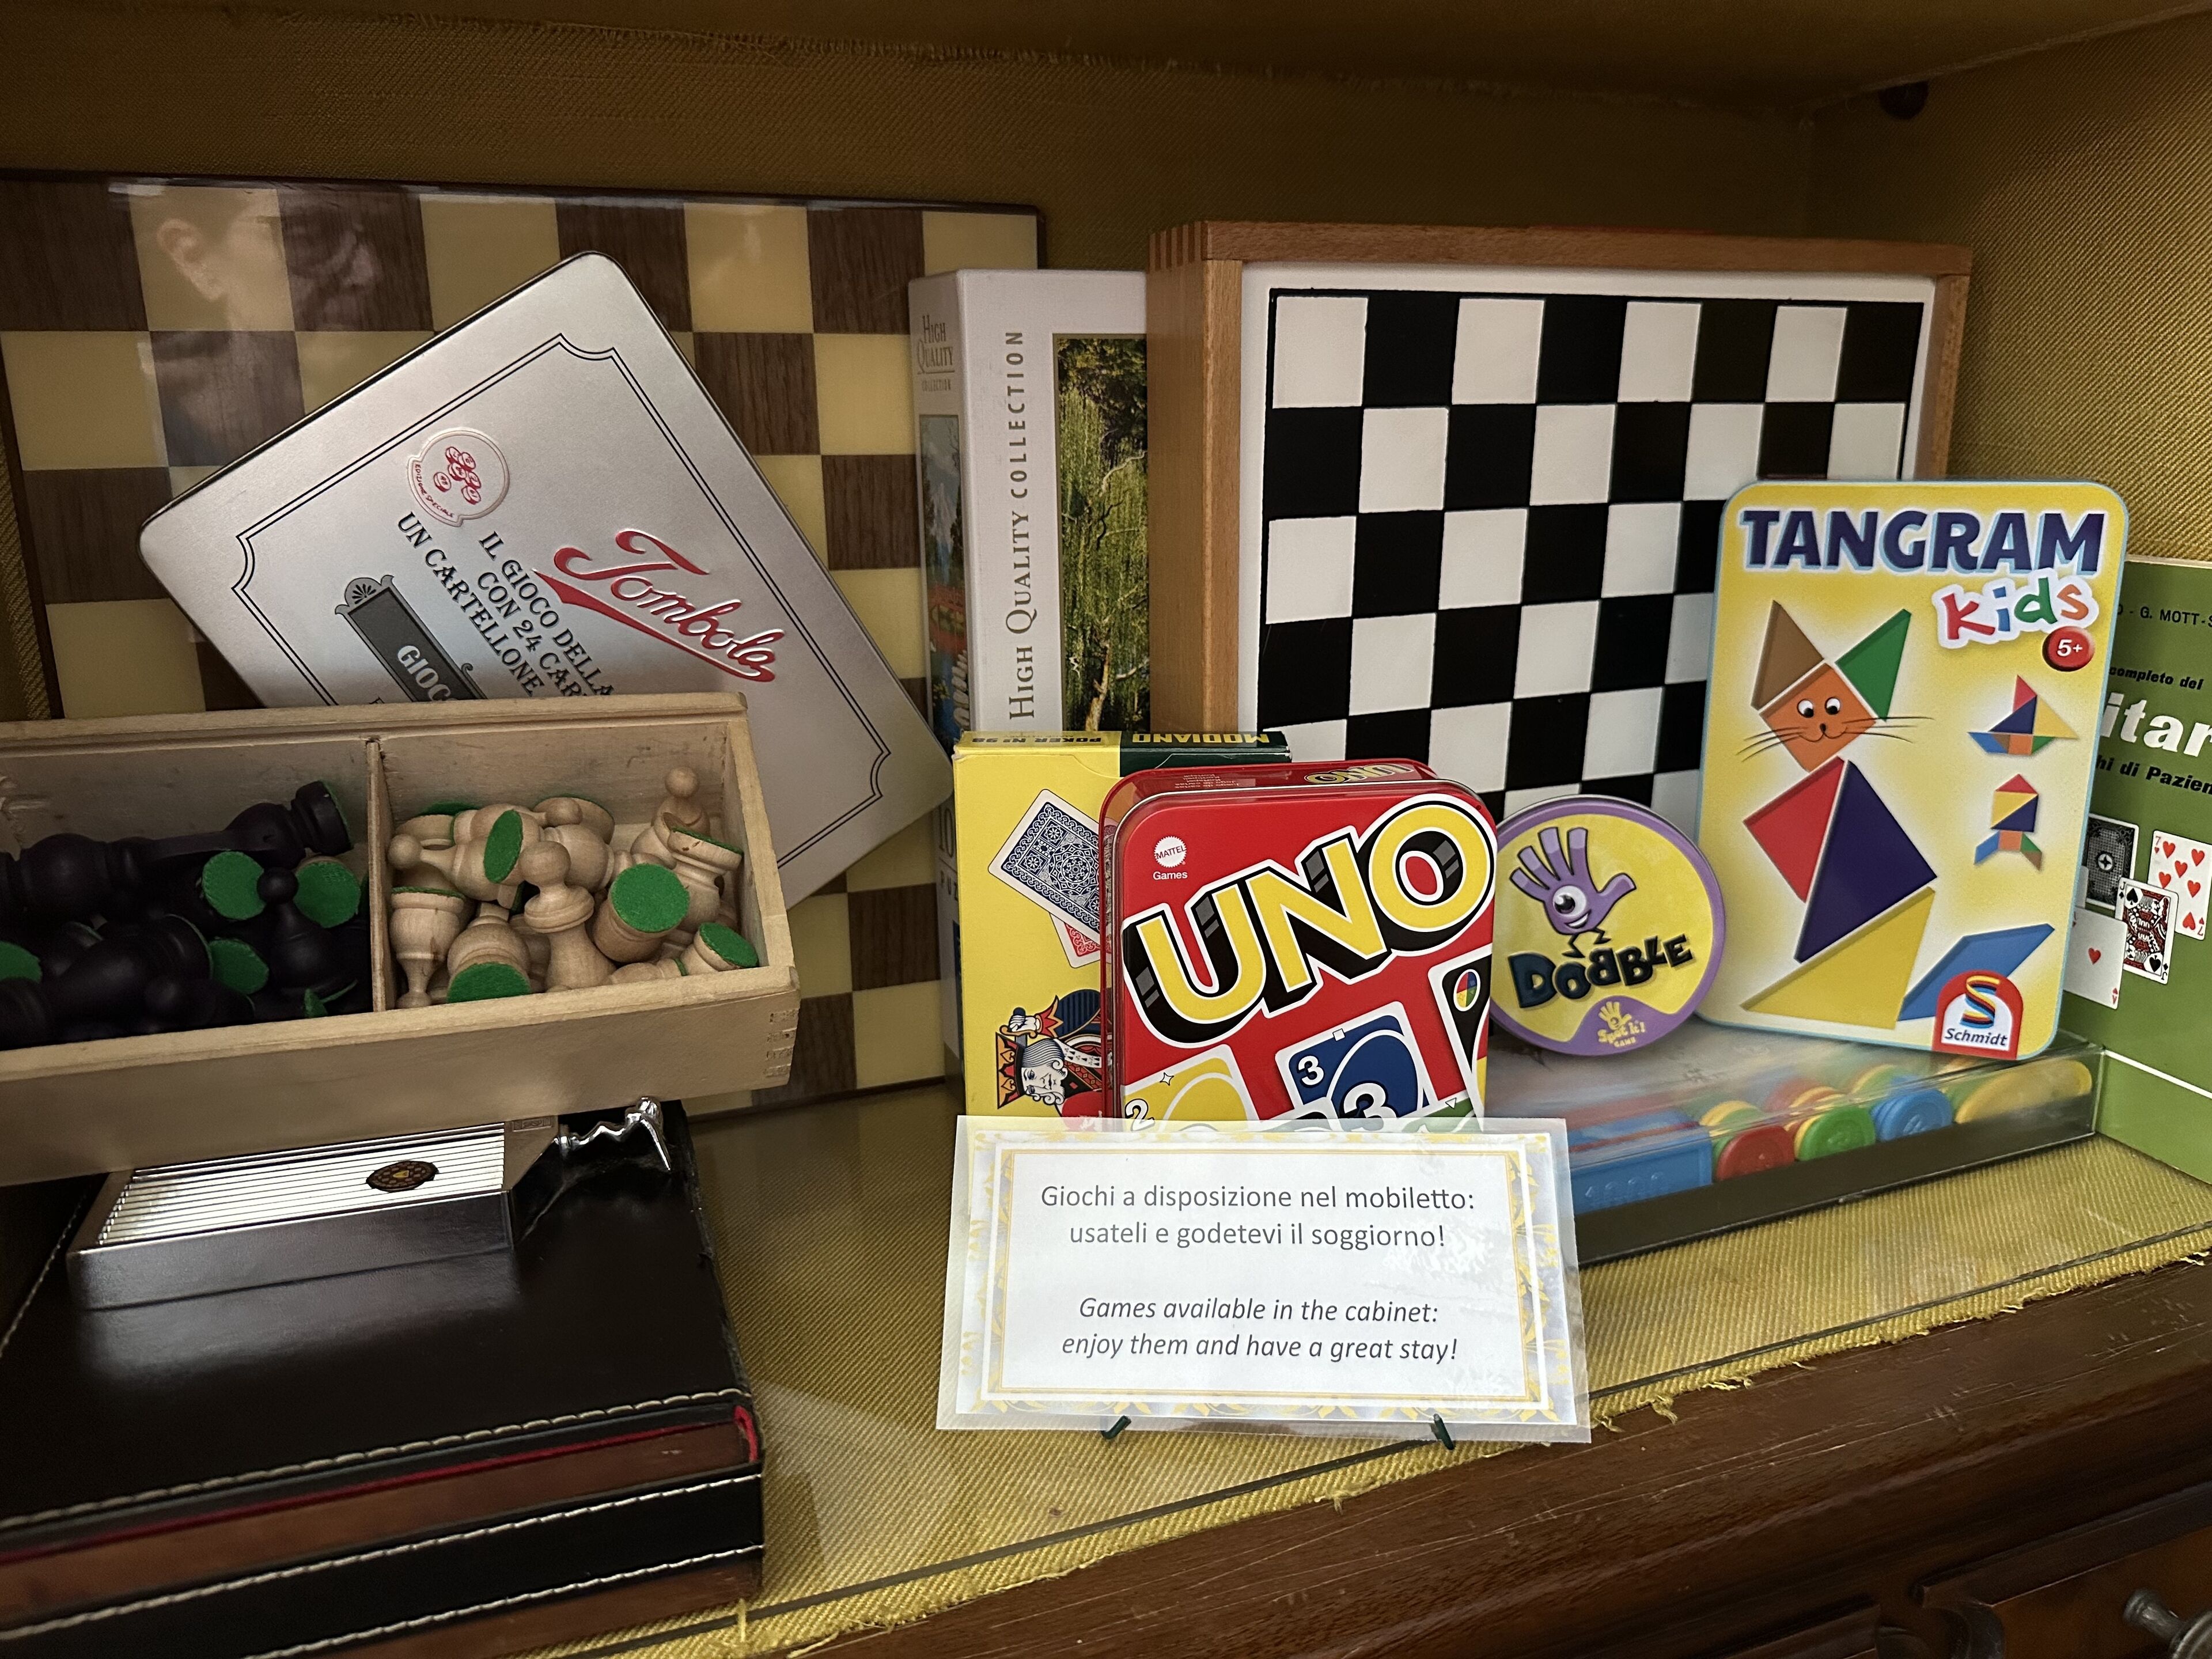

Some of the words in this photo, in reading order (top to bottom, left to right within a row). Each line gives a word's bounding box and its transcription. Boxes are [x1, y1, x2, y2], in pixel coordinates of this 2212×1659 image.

[917, 339, 953, 374] QUALITY
[1005, 332, 1028, 499] COLLECTION
[1741, 509, 2106, 573] TANGRAM
[479, 530, 504, 561] IL
[501, 559, 559, 629] GIOCO
[1006, 511, 1037, 634] QUALITY
[398, 512, 433, 548] UN
[425, 548, 545, 698] CARTELLONE
[533, 528, 785, 682] Tombola
[2140, 606, 2153, 619] G.
[477, 571, 522, 619] CON
[513, 620, 543, 653] 24
[540, 652, 588, 696] CAR
[2056, 638, 2084, 657] 5+
[397, 644, 460, 702] GIOC
[1009, 646, 1035, 719] HIGH
[2108, 666, 2174, 685] completo
[1132, 733, 1270, 744] MODIANO
[2100, 692, 2212, 758] itar
[1304, 763, 1415, 784] UNO
[2120, 761, 2141, 777] di
[2146, 766, 2212, 796] Pazien
[1156, 845, 1187, 859] MATTEL
[1153, 871, 1188, 880] Games
[1127, 797, 1494, 1041] UNO
[1944, 1028, 2009, 1046] Schmidt
[1297, 1054, 1325, 1087] 3
[1125, 1098, 1155, 1131] 2
[1041, 1185, 1115, 1207] Giochi
[1123, 1190, 1135, 1207] a
[1144, 1185, 1291, 1211] disposizione
[1301, 1186, 1336, 1207] nel
[1346, 1187, 1475, 1209] mobiletto:
[1070, 1222, 1147, 1243] usateli
[1156, 1227, 1169, 1244] e
[1177, 1222, 1282, 1248] godetevi
[1291, 1223, 1303, 1244] il
[1312, 1225, 1445, 1251] soggiorno!
[1080, 1298, 1156, 1318] Games
[1164, 1298, 1266, 1319] available
[1273, 1300, 1293, 1320] in
[1301, 1299, 1338, 1320] the
[1345, 1300, 1438, 1323] cabinet:
[1062, 1333, 1123, 1359] enjoy
[1131, 1333, 1188, 1354] them
[1196, 1334, 1239, 1355] and
[1246, 1334, 1301, 1357] have
[1309, 1342, 1323, 1357] a
[1330, 1339, 1393, 1363] great
[1400, 1338, 1457, 1365] stay!
